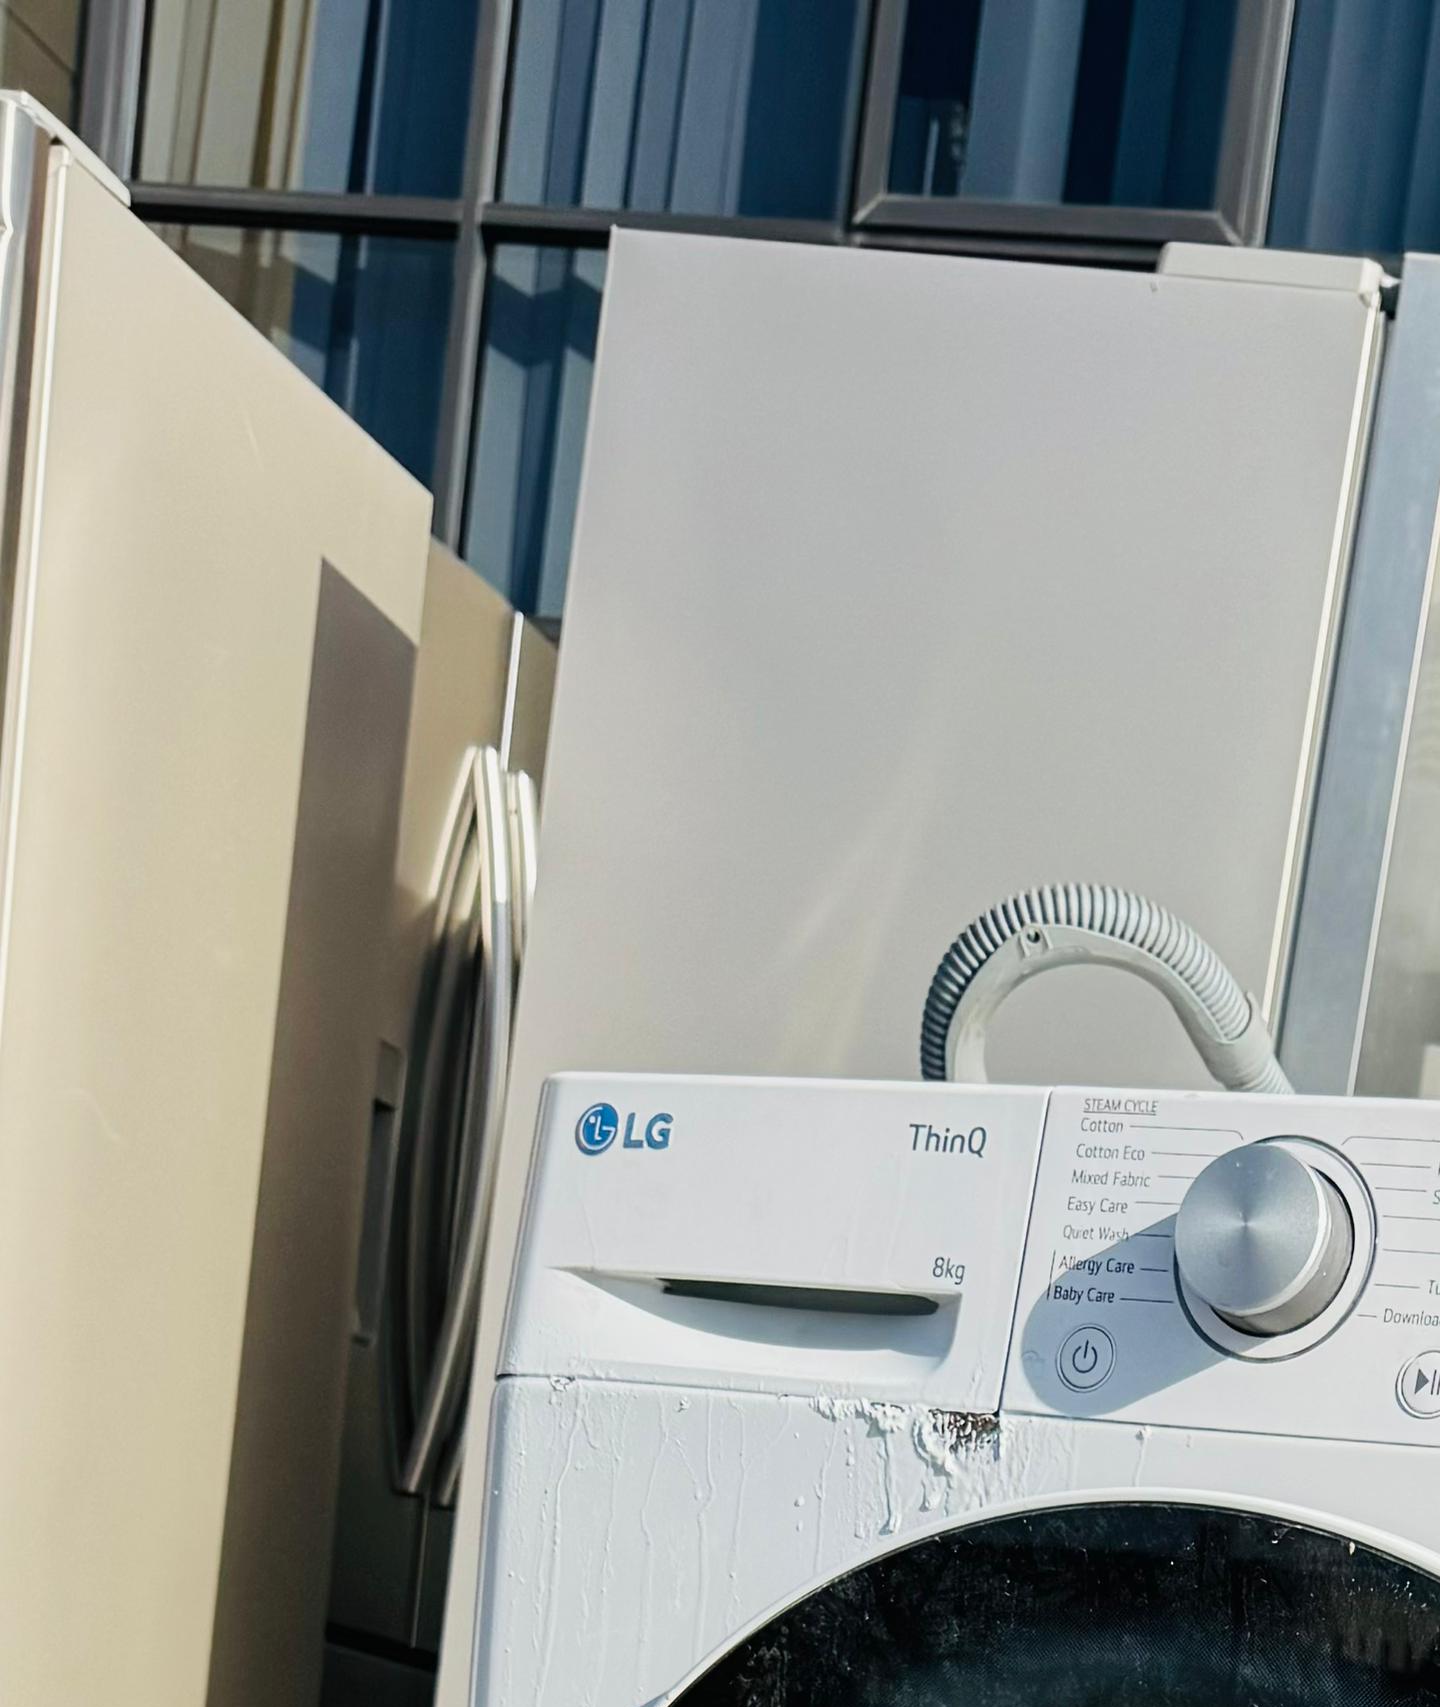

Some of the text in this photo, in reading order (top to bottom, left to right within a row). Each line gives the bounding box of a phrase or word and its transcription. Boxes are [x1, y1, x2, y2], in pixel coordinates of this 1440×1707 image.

[1083, 1098, 1159, 1114] STEAM CYCLE
[622, 1112, 674, 1150] LG
[1080, 1117, 1123, 1133] Cotton
[909, 1123, 988, 1159] ThinQ
[1076, 1143, 1145, 1161] Cotton Eco
[1071, 1169, 1151, 1188] Mixed Fabric
[1067, 1196, 1128, 1216] Easy Care
[1062, 1224, 1130, 1242] Quiet Wash
[931, 1256, 966, 1285] 8kg
[1058, 1254, 1136, 1276] Allergy Care
[1052, 1285, 1115, 1306] Baby Care
